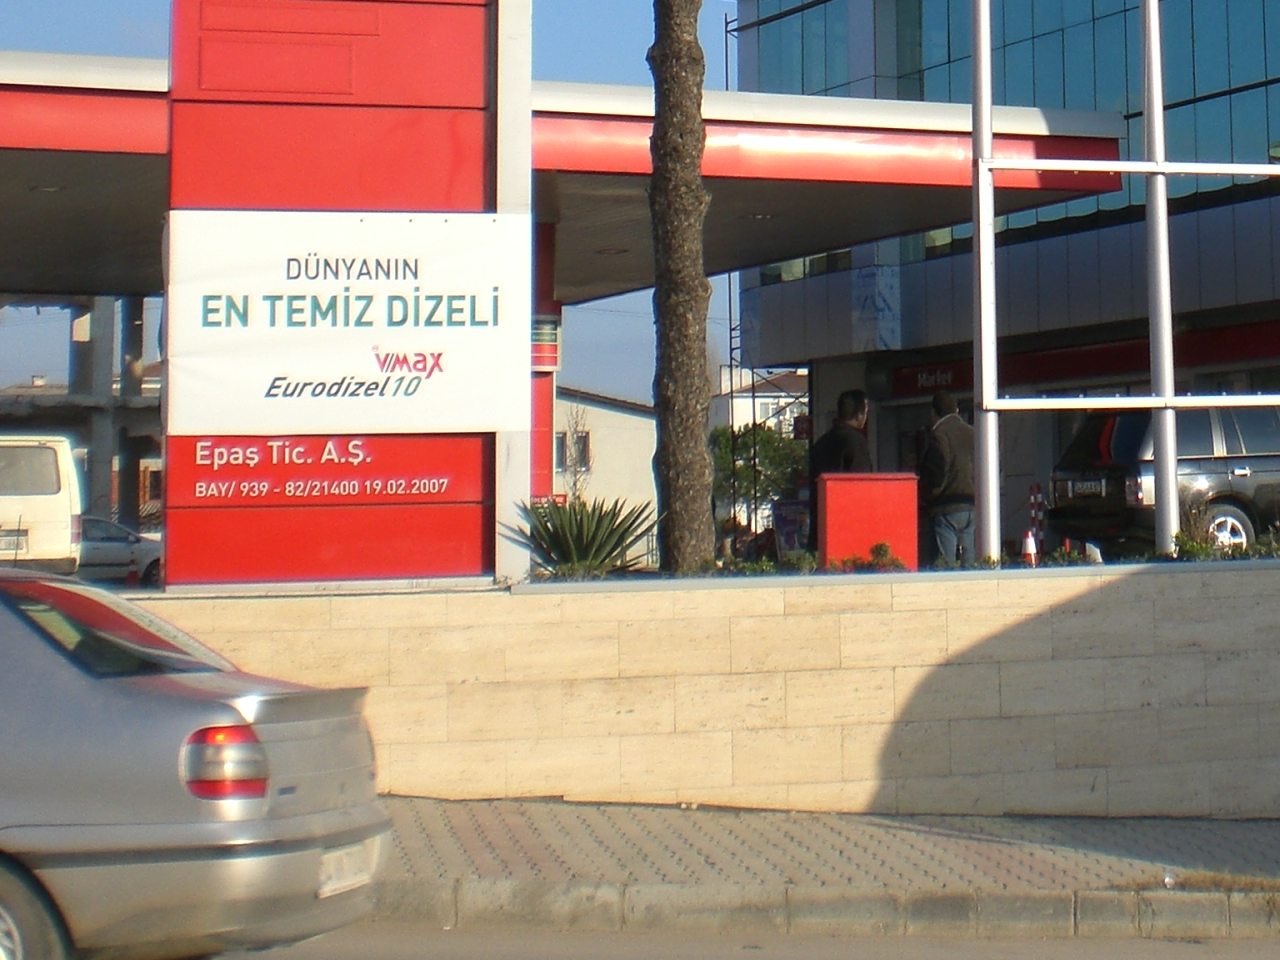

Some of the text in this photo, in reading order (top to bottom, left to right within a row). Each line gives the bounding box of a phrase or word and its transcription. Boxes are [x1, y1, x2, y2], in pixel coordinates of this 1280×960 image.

[286, 252, 419, 281] DÜNYANIN
[202, 286, 499, 328] EN TEMİZ DİZELİ
[195, 440, 372, 470] Epaş Tic. A.Ş.
[195, 481, 236, 498] BAY/
[239, 481, 269, 497] 939
[284, 479, 359, 498] 82/21400
[364, 478, 449, 496] 19.02.2007
